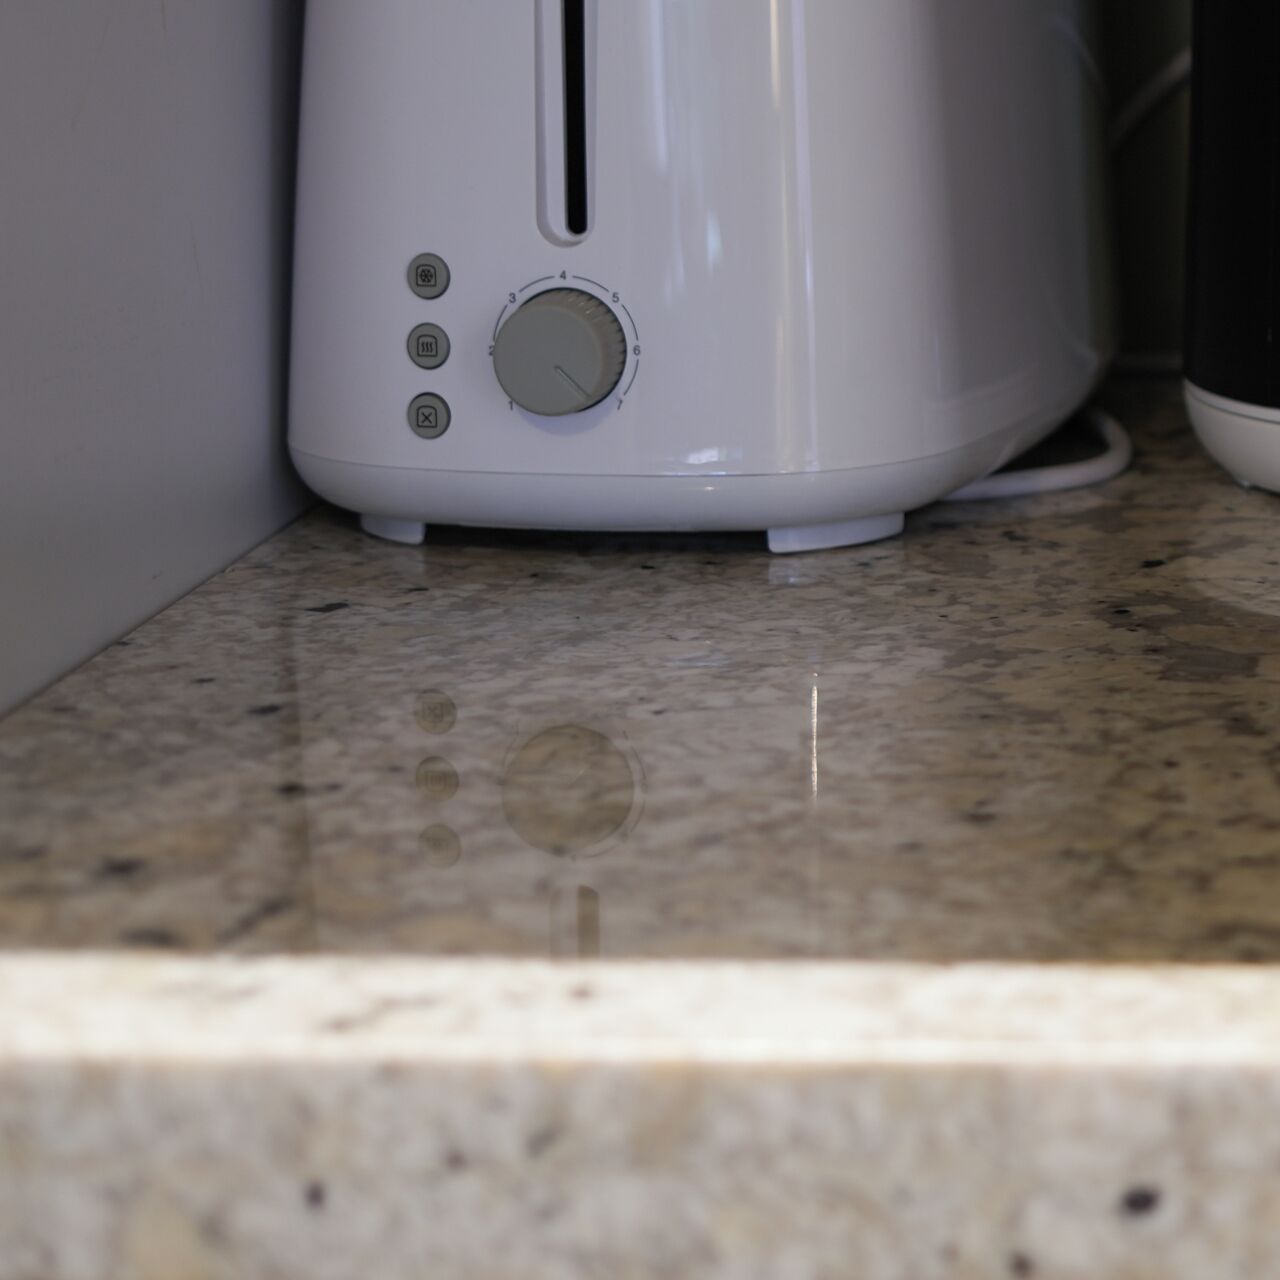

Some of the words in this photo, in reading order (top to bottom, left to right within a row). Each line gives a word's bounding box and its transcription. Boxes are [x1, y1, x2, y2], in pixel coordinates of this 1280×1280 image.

[559, 270, 567, 280] 4
[508, 292, 517, 304] 3
[612, 292, 620, 303] 5
[488, 344, 496, 356] 2
[632, 344, 641, 356] 6
[507, 400, 514, 411] 1
[616, 399, 624, 410] 7
